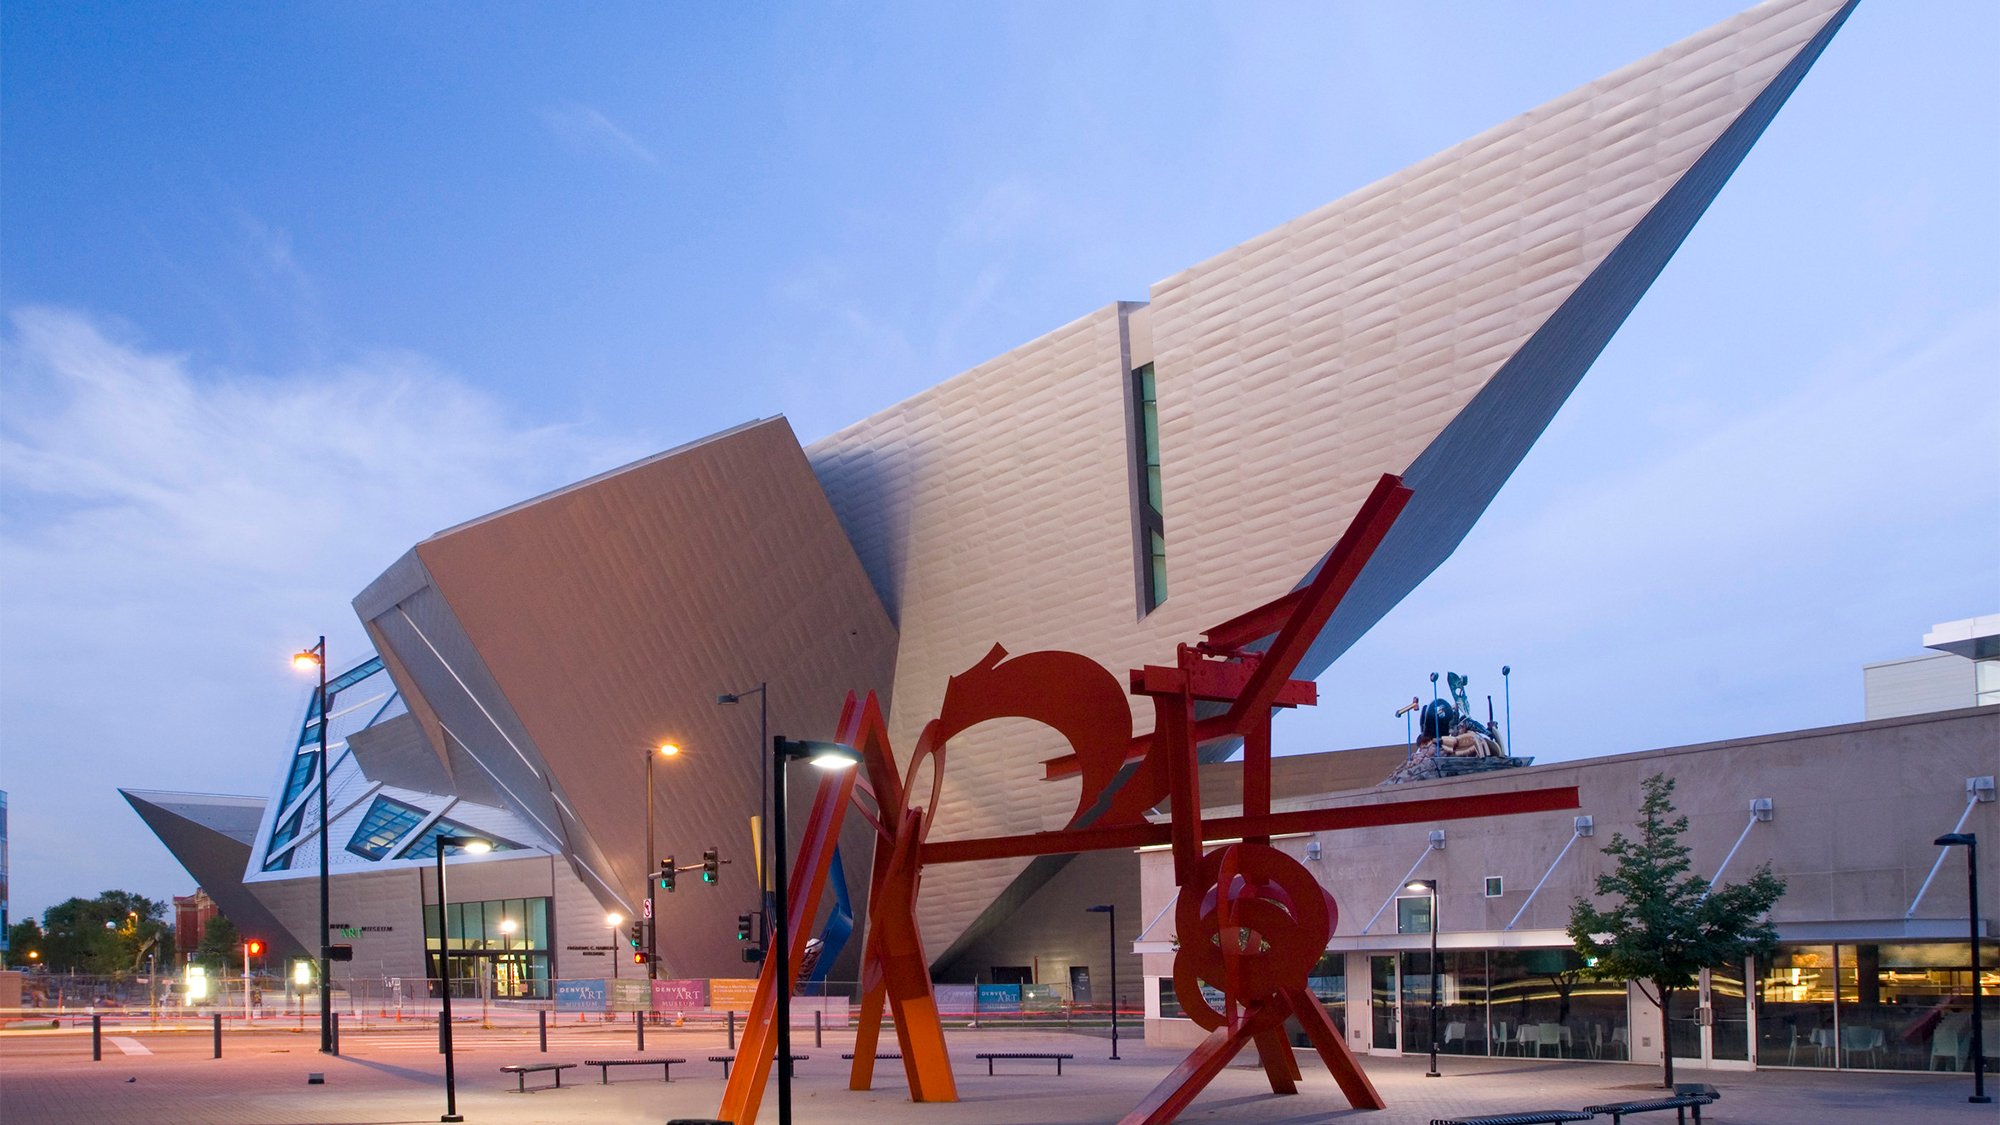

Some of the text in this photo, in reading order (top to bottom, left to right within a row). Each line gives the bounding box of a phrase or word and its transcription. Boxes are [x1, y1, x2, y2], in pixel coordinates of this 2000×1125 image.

[341, 928, 362, 938] ART
[579, 991, 603, 1000] ART
[676, 991, 700, 1000] ART
[998, 993, 1017, 1002] ART
